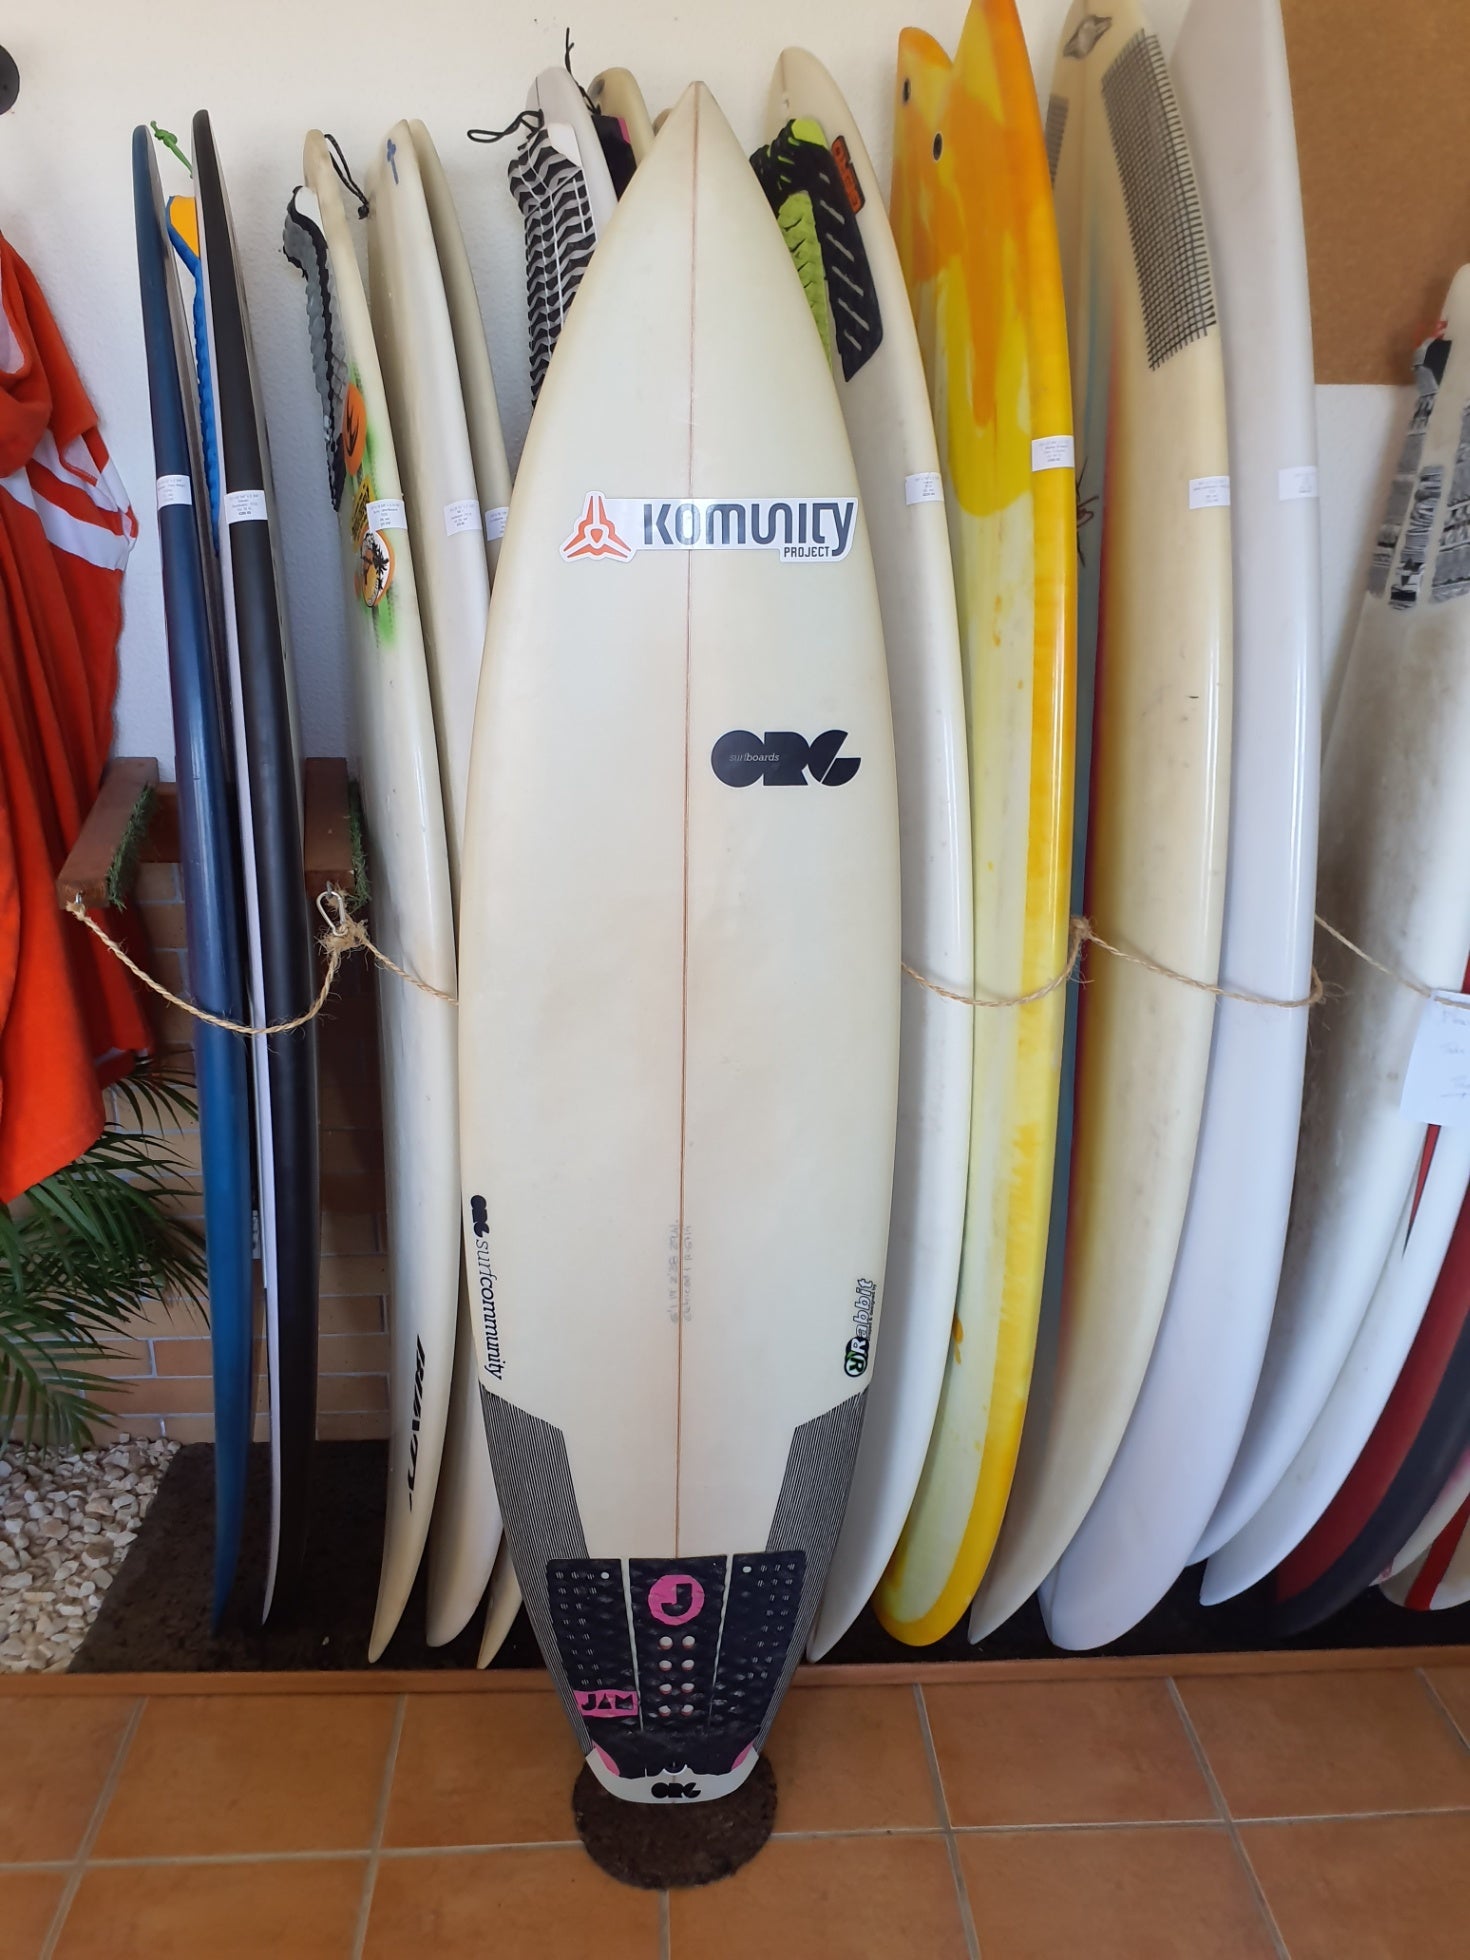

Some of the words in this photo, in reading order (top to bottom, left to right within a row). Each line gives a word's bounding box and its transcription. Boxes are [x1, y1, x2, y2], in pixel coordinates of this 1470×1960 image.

[783, 546, 829, 557] PROJECT
[475, 1239, 506, 1381] surfcommunity
[660, 1582, 693, 1617] J
[581, 1693, 634, 1711] JAM
